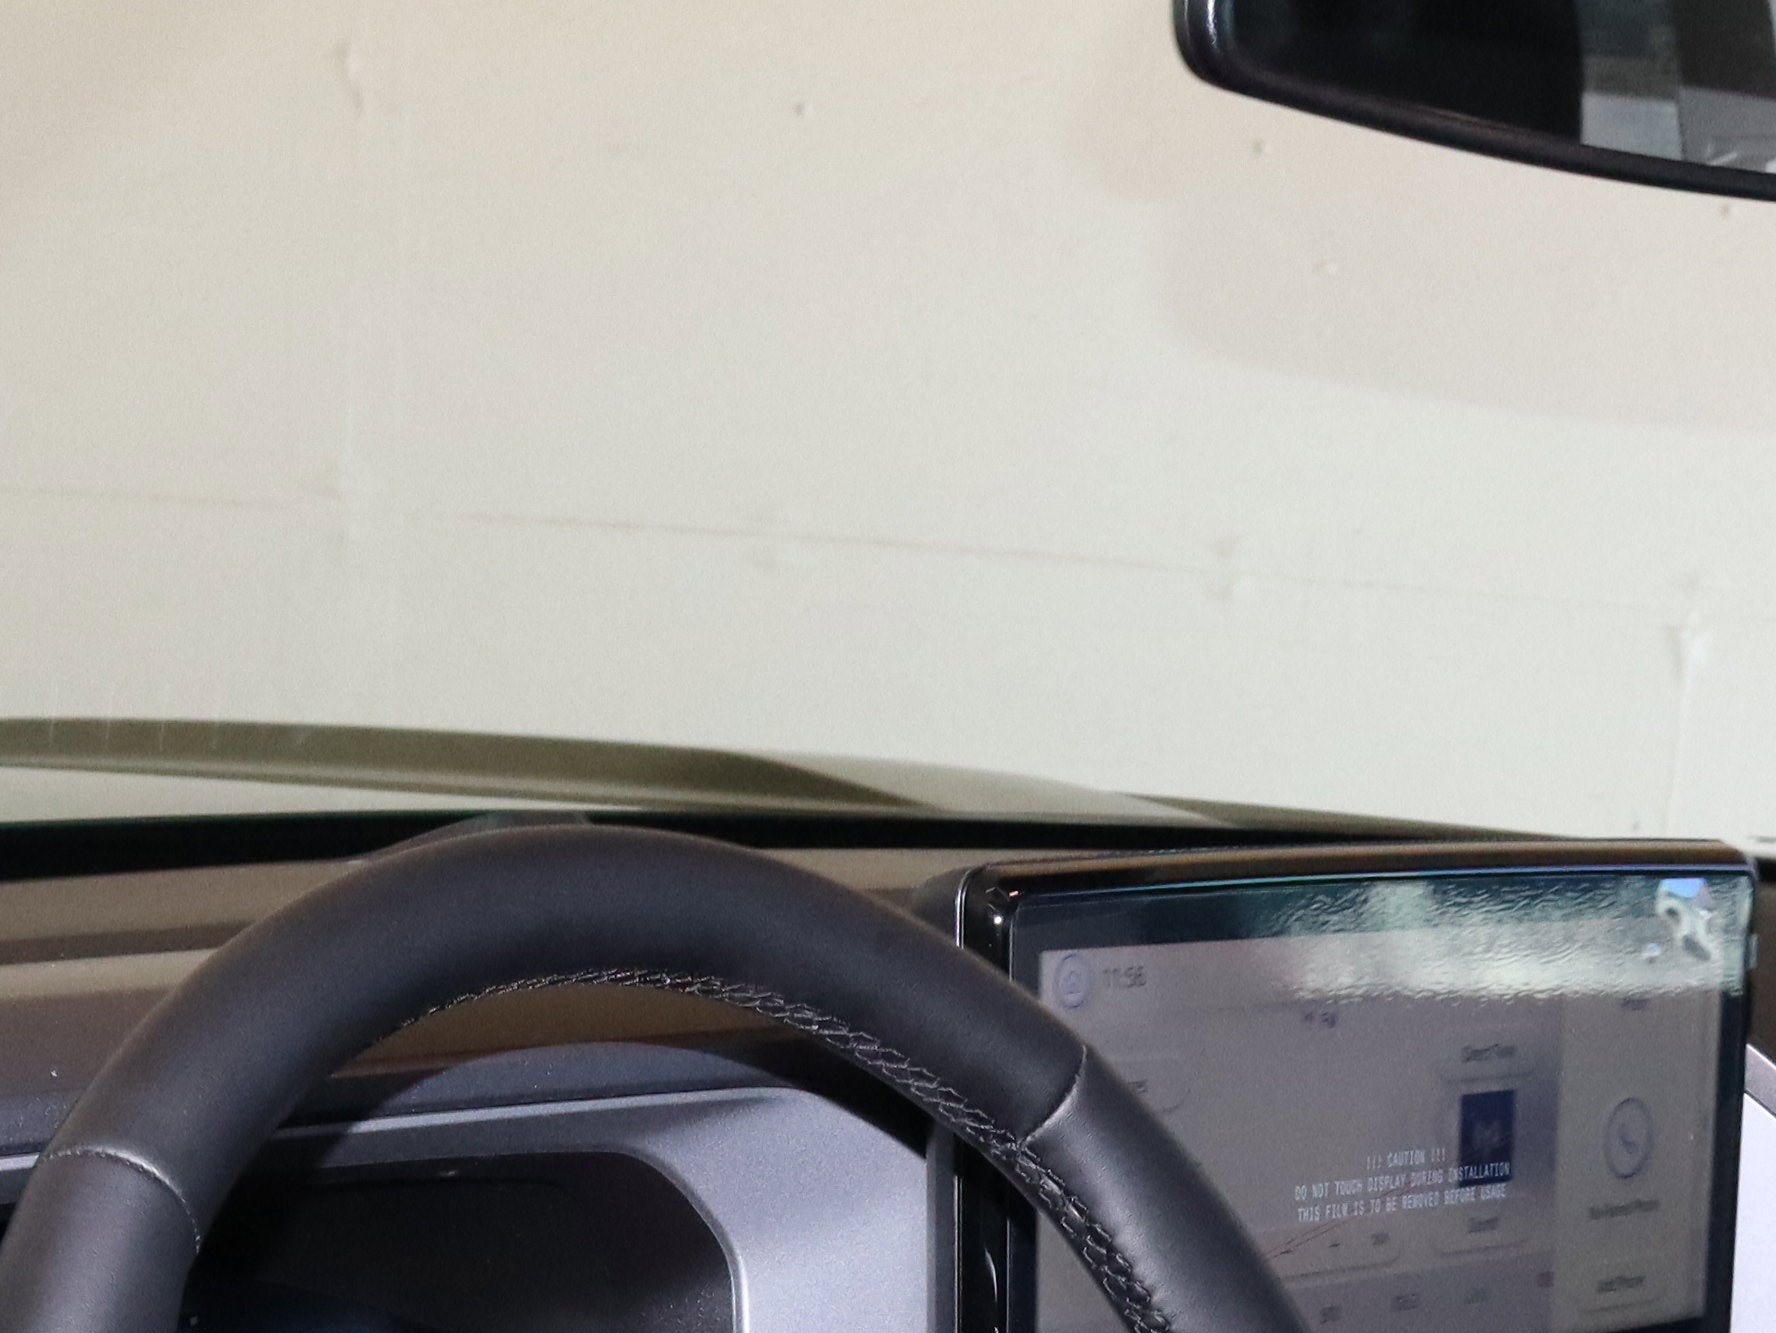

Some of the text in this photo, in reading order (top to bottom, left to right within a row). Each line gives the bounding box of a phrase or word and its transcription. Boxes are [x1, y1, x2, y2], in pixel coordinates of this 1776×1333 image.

[1388, 1150, 1425, 1168] CAUTION
[1294, 1185, 1308, 1200] DO
[1312, 1181, 1330, 1197] NOT
[1335, 1178, 1363, 1196] TOUCH
[1367, 1174, 1406, 1193] DISPLAY
[1448, 1161, 1512, 1184] INSTALLATION
[1297, 1206, 1321, 1223] THIS
[1325, 1203, 1349, 1219] FILM
[1354, 1200, 1366, 1216] IS
[1370, 1198, 1382, 1214] TO
